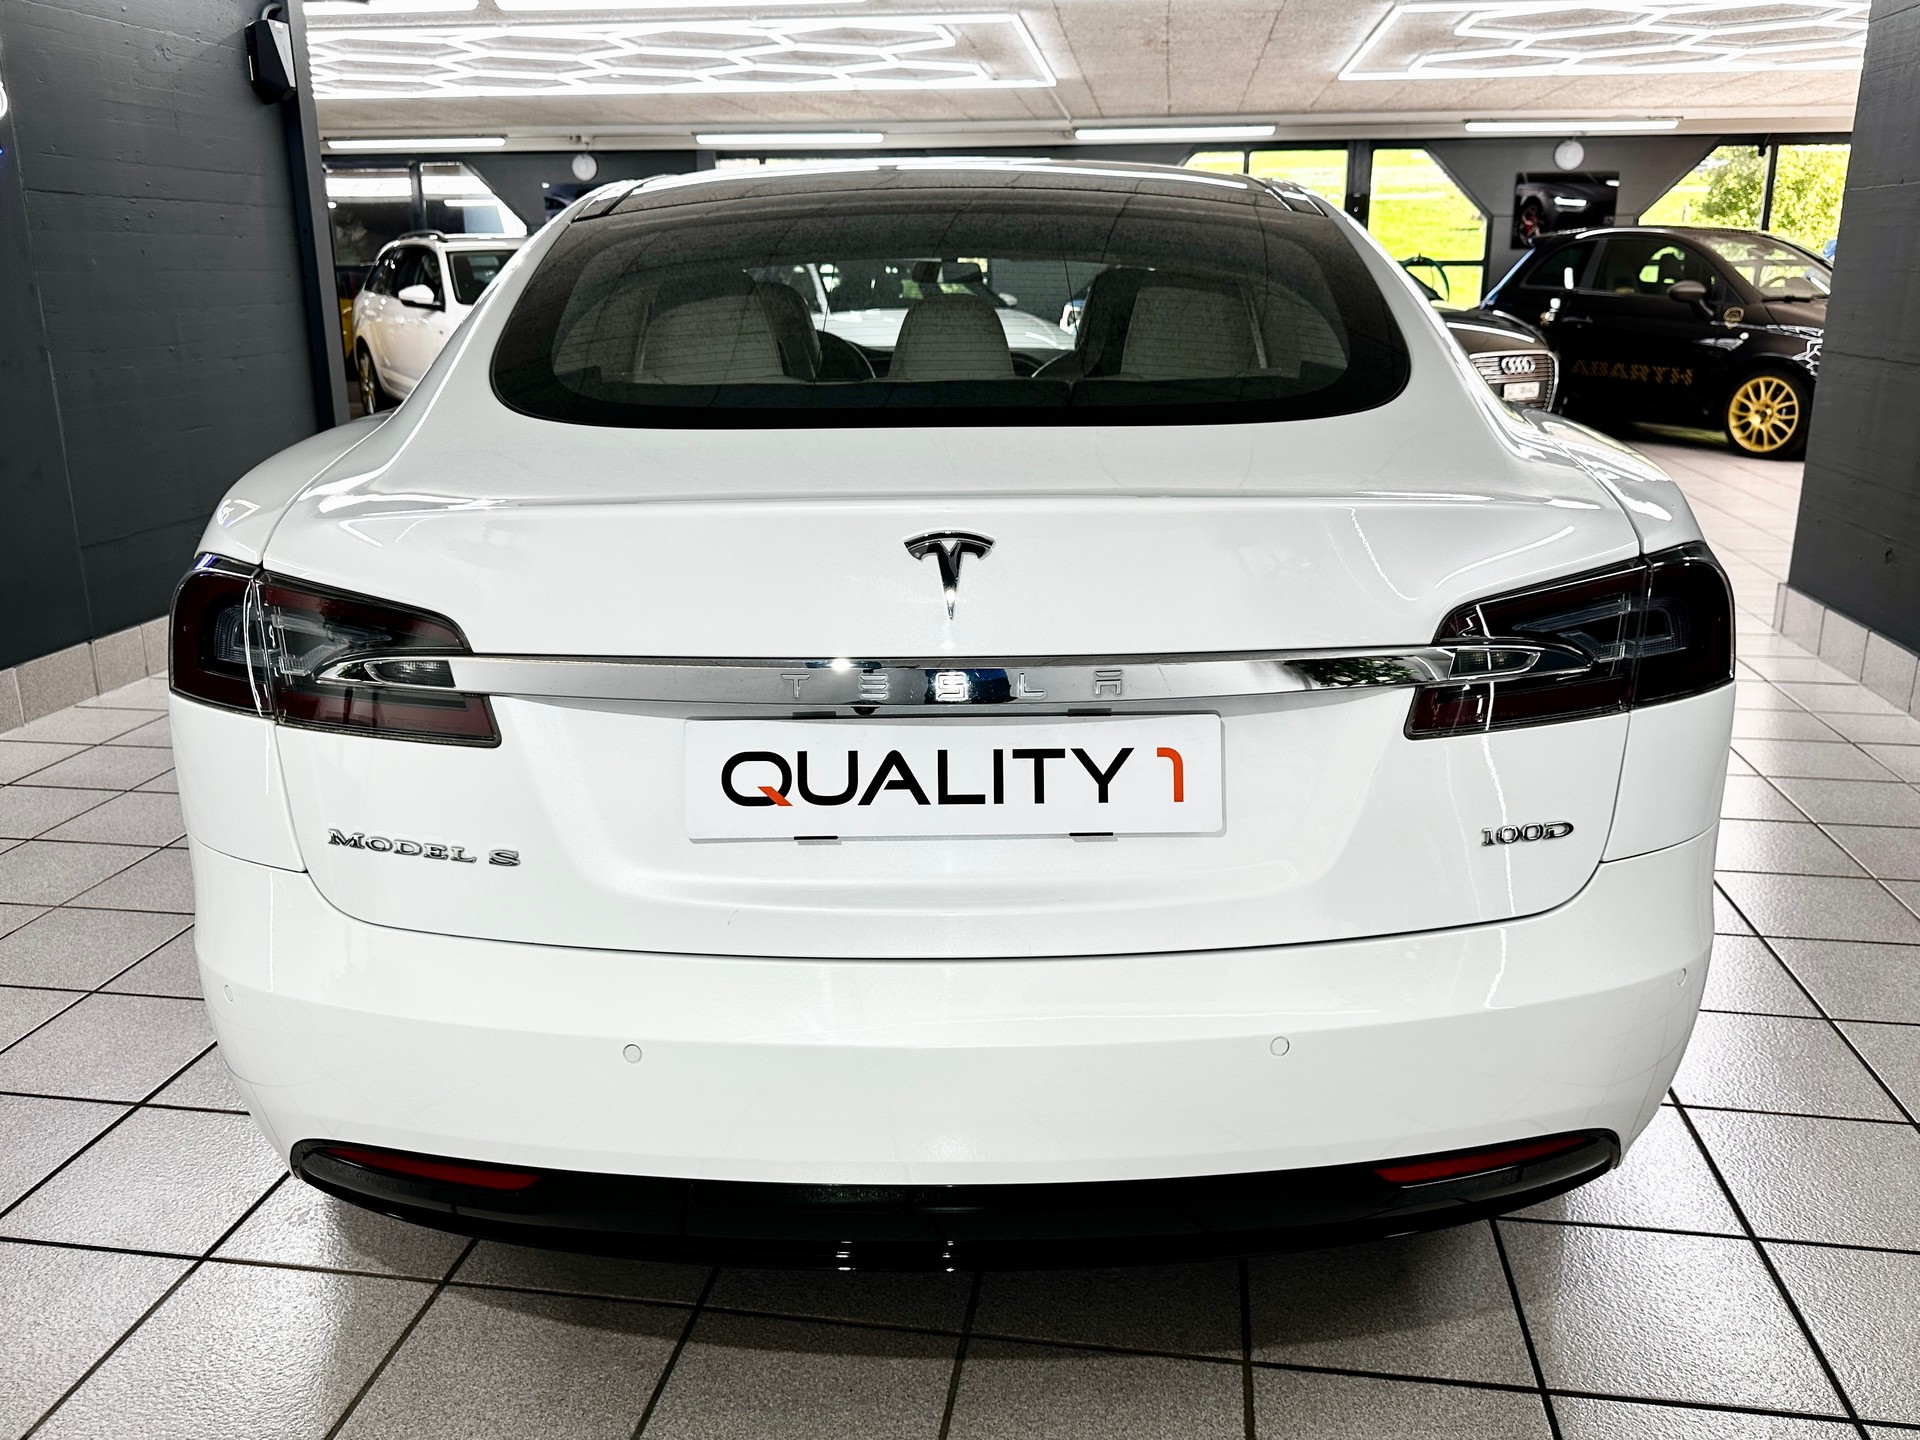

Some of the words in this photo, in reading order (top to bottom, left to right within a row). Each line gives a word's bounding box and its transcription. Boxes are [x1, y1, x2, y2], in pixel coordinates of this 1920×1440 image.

[1571, 359, 1694, 385] ABARTH
[781, 669, 1123, 702] TESLA
[721, 747, 1135, 807] QUALITY
[1157, 747, 1184, 803] 1
[327, 828, 477, 864] MODEL
[488, 848, 521, 867] S
[1482, 820, 1574, 846] 100D
